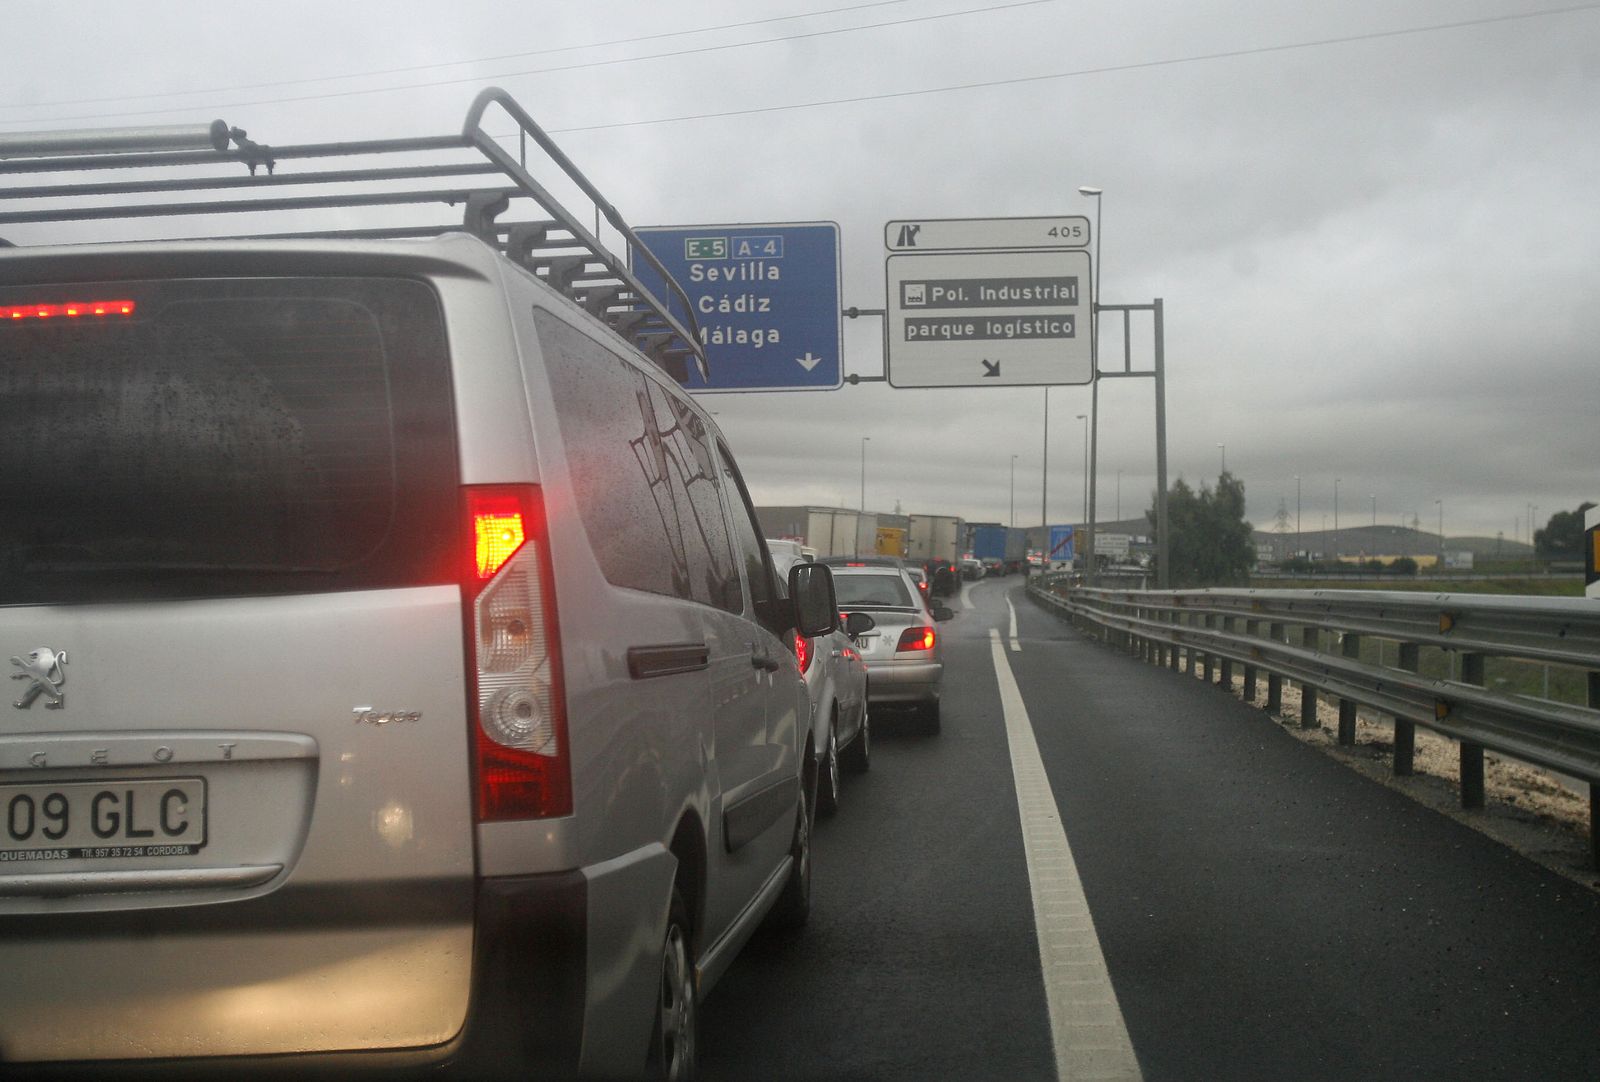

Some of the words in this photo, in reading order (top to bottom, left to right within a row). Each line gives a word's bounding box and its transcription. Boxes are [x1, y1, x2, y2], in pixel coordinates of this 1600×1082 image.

[1048, 226, 1081, 238] 405
[688, 241, 724, 256] E-5
[738, 240, 777, 256] A-4
[690, 261, 780, 281] Sevilla
[932, 287, 969, 301] Pol.
[980, 285, 1076, 300] Industrial
[699, 294, 771, 313] Cádiz
[907, 324, 975, 340] parque
[987, 319, 1072, 337] logístico
[91, 789, 189, 839] GLC
[0, 849, 69, 861] QUEMADAS
[147, 846, 190, 856] CORDOBA
